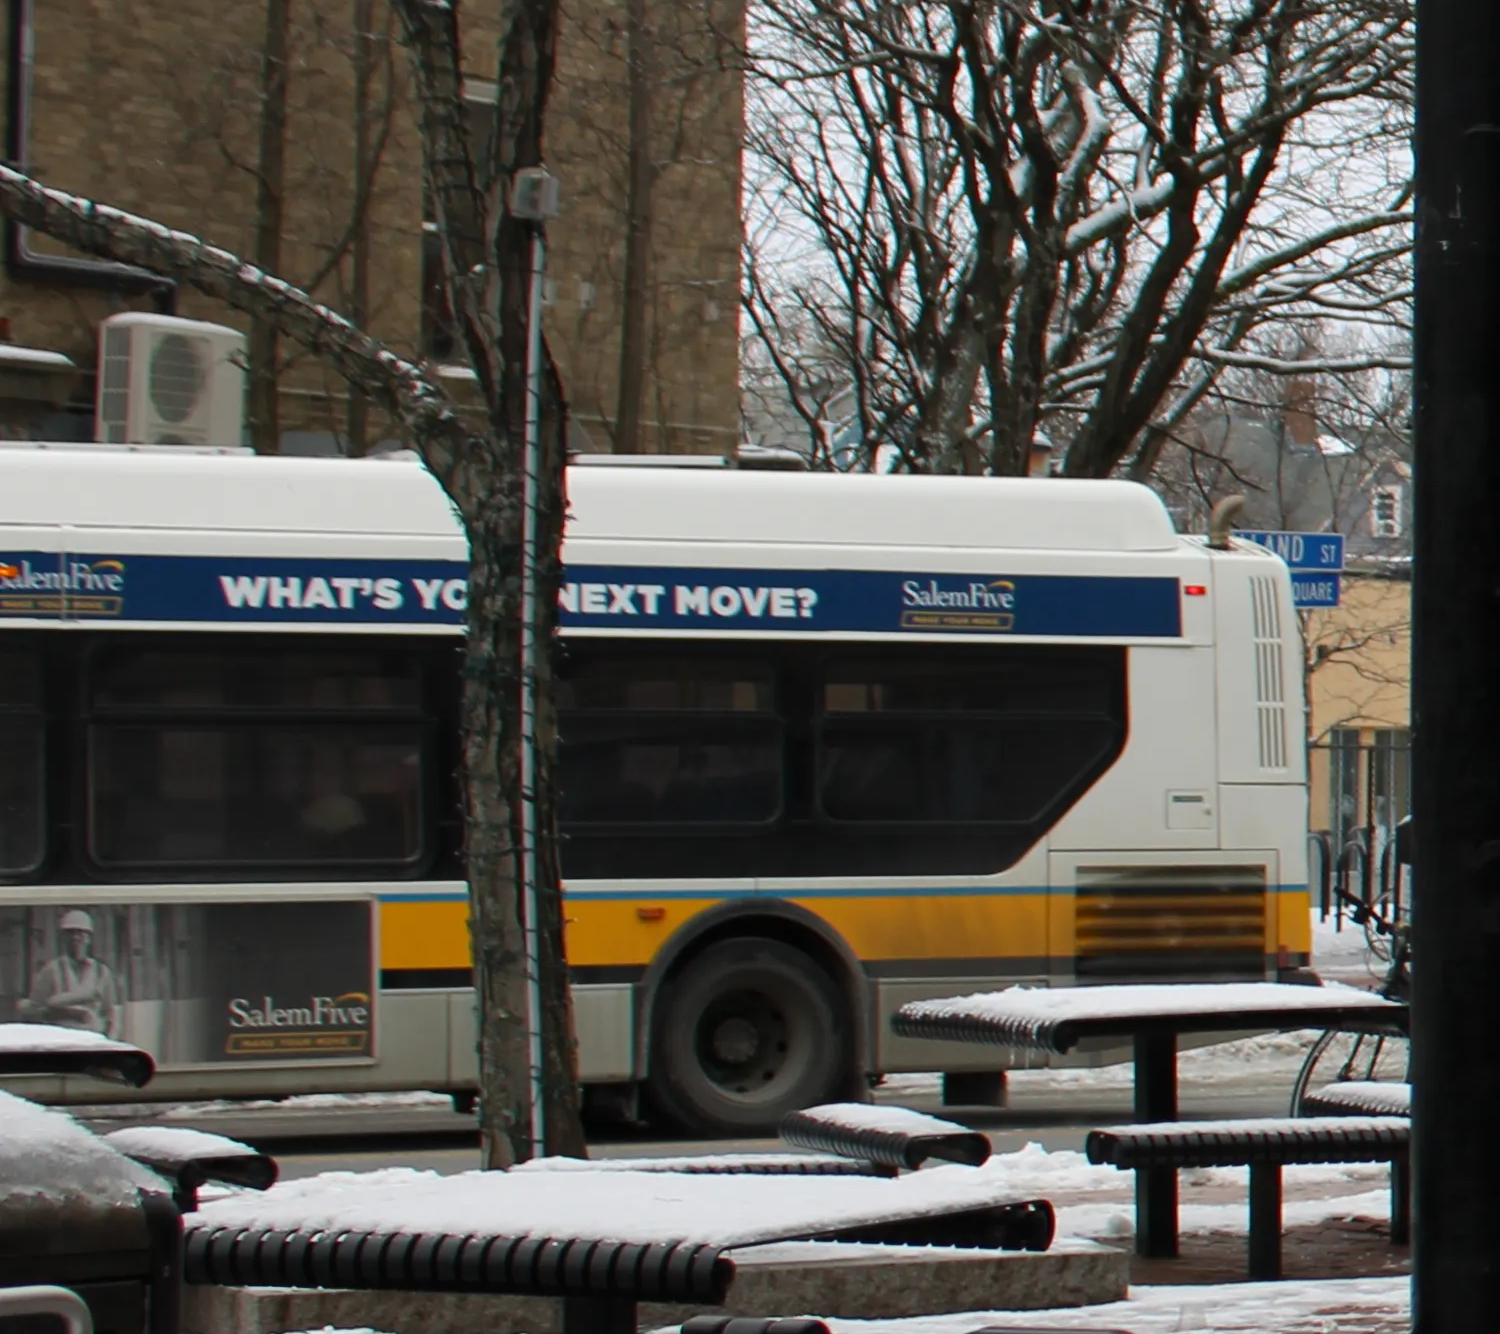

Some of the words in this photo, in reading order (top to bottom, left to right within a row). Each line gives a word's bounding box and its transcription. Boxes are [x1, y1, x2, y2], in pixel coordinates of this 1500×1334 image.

[1319, 544, 1337, 563] ST
[218, 575, 405, 610] WHAT'S
[411, 578, 469, 610] YO
[558, 583, 666, 614] NEXT
[673, 585, 818, 618] MOVE?
[902, 580, 1015, 608] SalemFive
[1293, 581, 1334, 601] QUARE
[228, 995, 368, 1027] SalemFive
